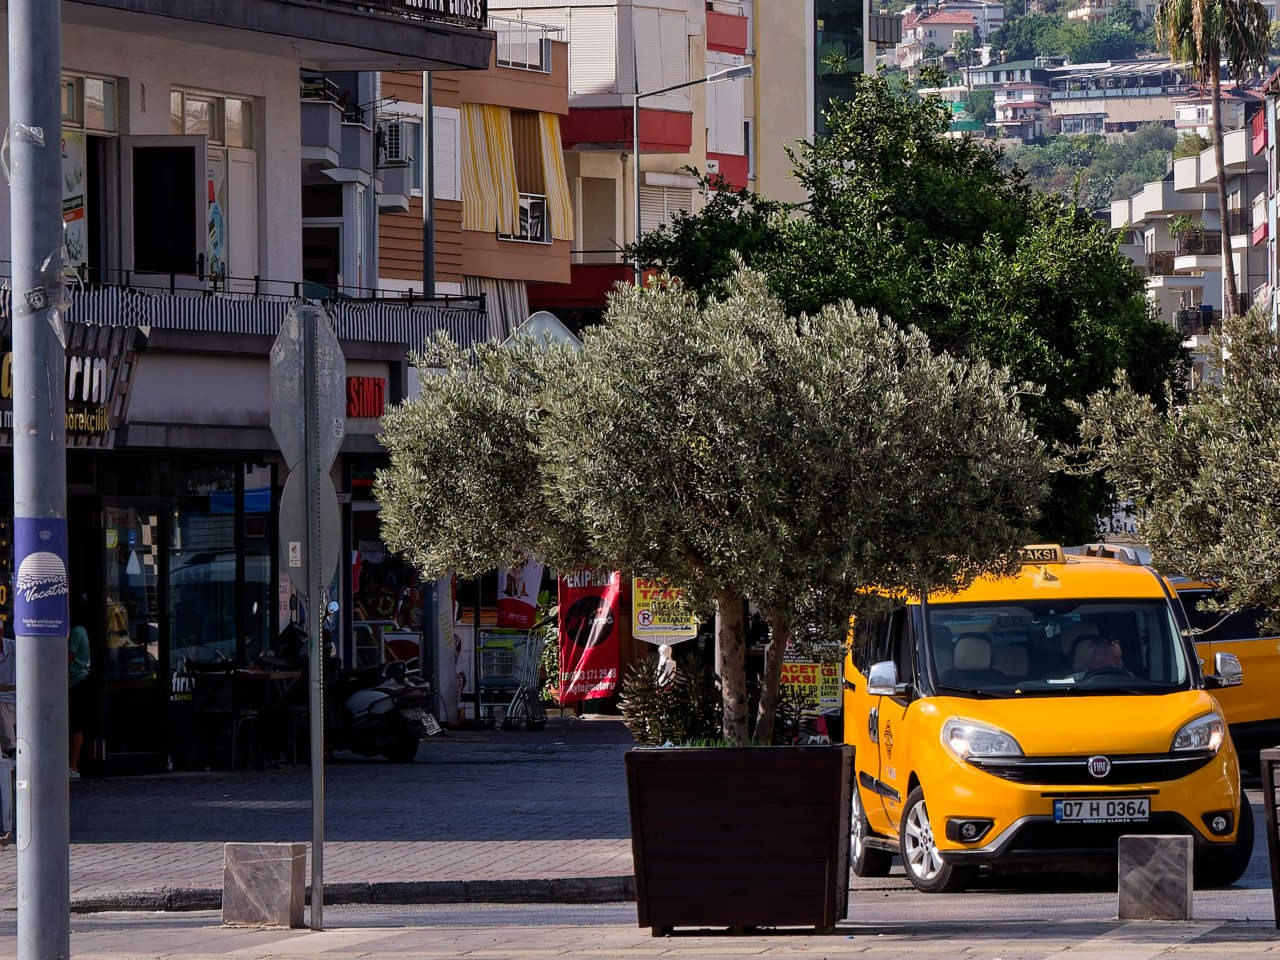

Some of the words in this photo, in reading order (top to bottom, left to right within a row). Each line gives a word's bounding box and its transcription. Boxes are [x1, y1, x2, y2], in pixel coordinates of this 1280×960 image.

[16, 575, 67, 596] Summer
[24, 583, 69, 602] Vacation
[1063, 802, 1083, 818] 07
[1090, 802, 1100, 817] H
[1107, 801, 1146, 817] 0364
